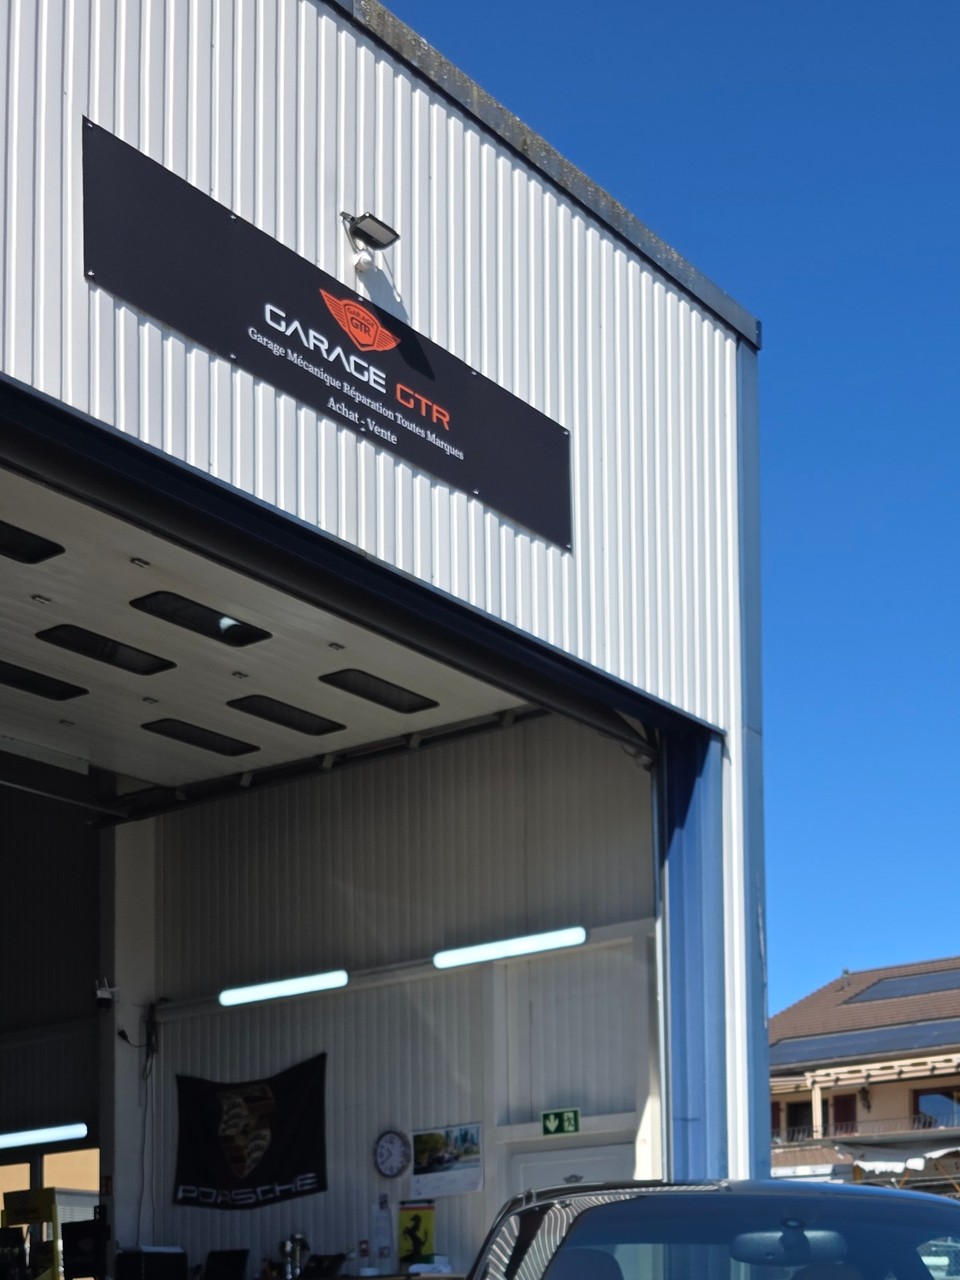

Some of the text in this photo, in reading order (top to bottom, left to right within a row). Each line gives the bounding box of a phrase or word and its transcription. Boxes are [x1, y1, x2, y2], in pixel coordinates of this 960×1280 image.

[350, 316, 372, 338] GTR
[264, 303, 450, 431] GARAGE GTR
[248, 327, 464, 460] Garage Mécanique Réparation Toutes Marques
[327, 397, 360, 424] Achat
[366, 418, 398, 445] Vente
[177, 1172, 318, 1205] PORSCHE
